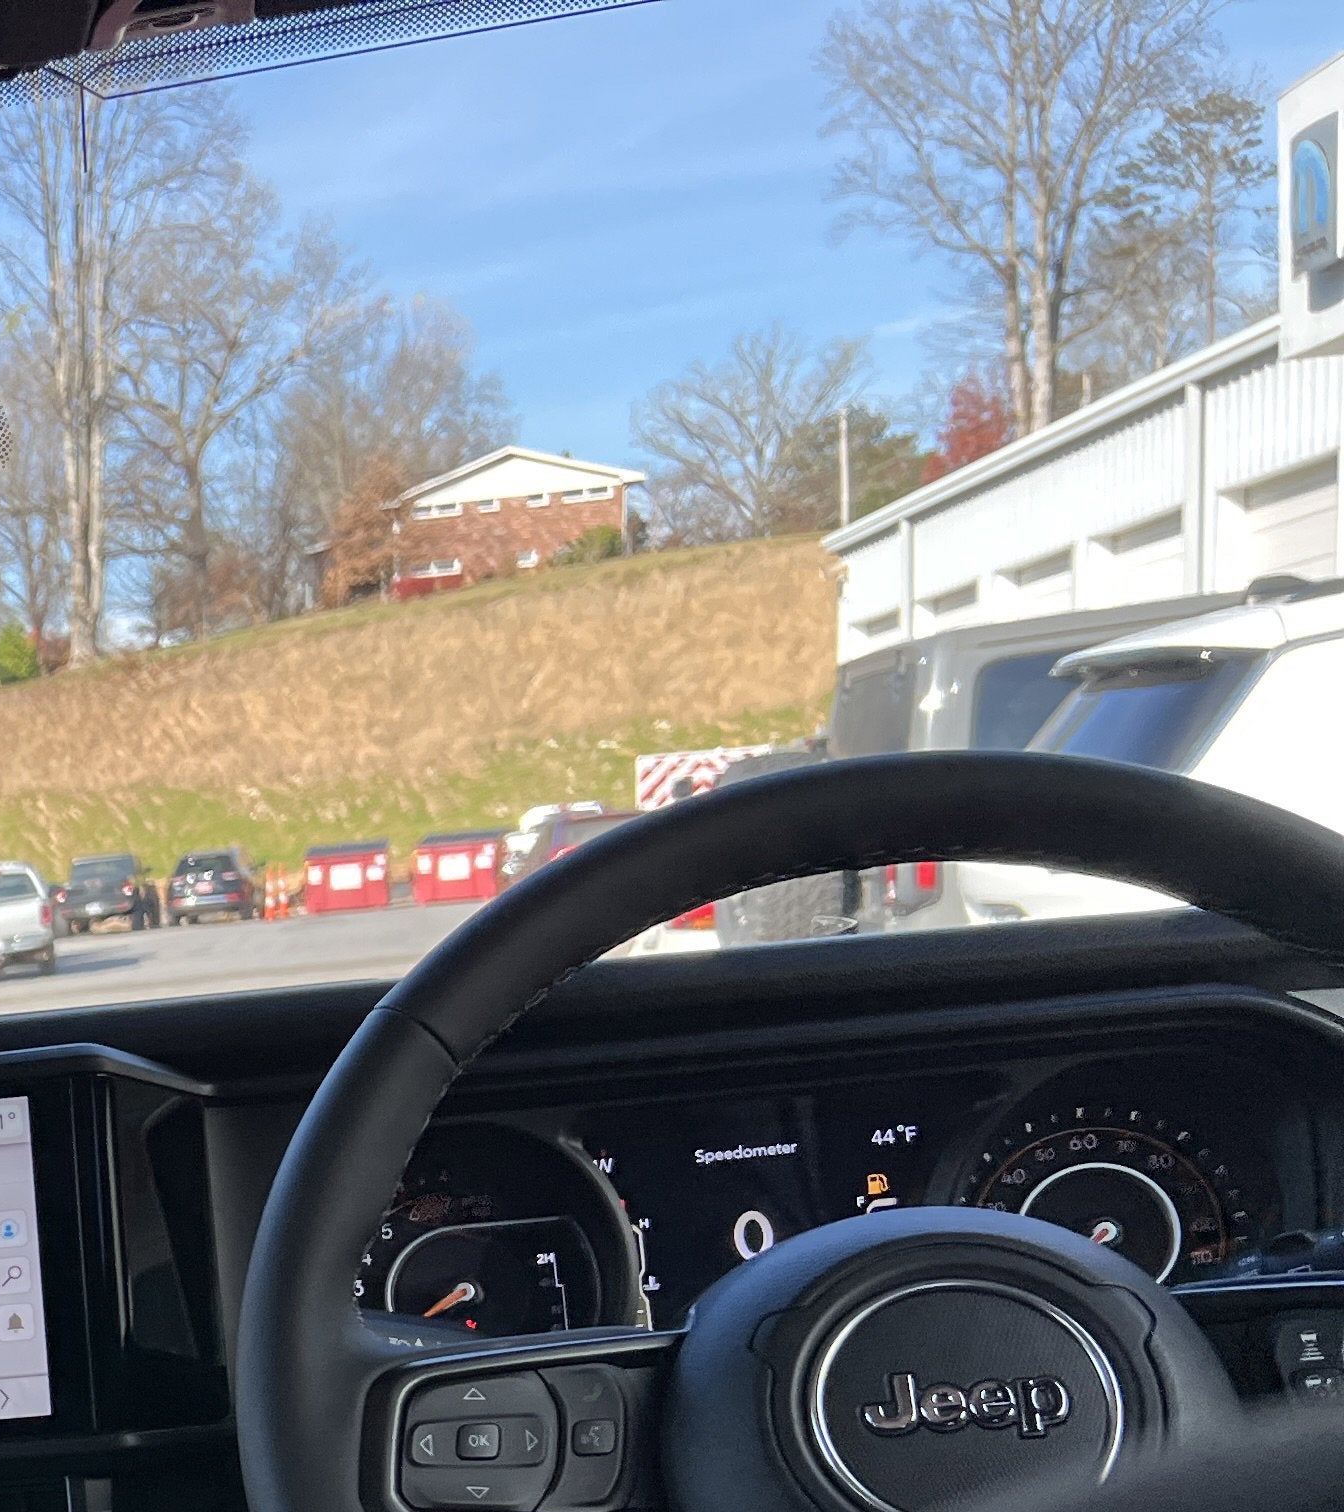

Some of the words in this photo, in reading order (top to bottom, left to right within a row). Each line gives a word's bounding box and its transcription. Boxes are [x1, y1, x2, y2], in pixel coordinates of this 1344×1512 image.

[694, 1141, 799, 1165] Speedometer
[863, 1372, 1071, 1438] Jeep
[468, 1434, 490, 1448] OK
